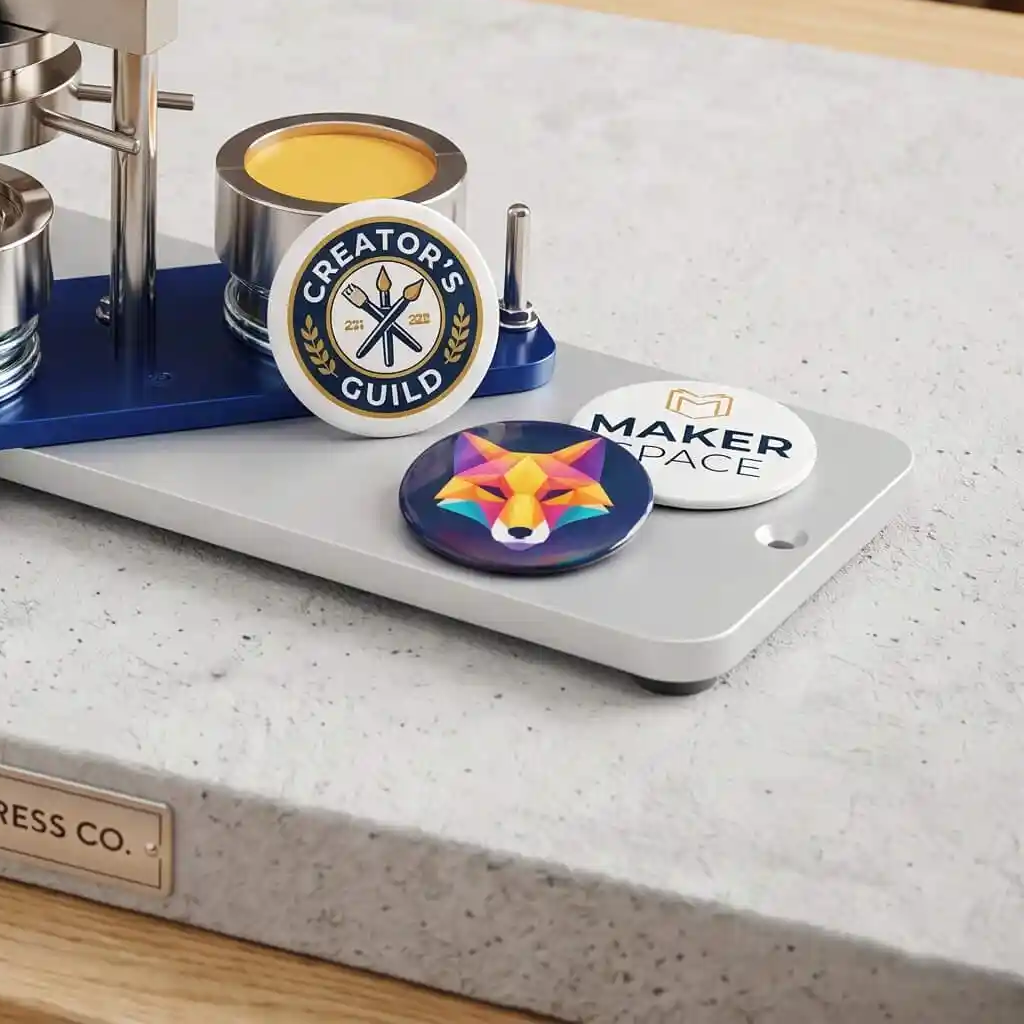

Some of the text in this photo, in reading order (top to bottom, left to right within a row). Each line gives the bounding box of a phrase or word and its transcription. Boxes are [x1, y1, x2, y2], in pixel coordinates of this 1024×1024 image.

[303, 228, 465, 304] CREATOR'S
[340, 368, 442, 407] GUILD
[590, 413, 793, 459] MAKER
[616, 441, 764, 478] PACE
[76, 822, 132, 856] CO.
